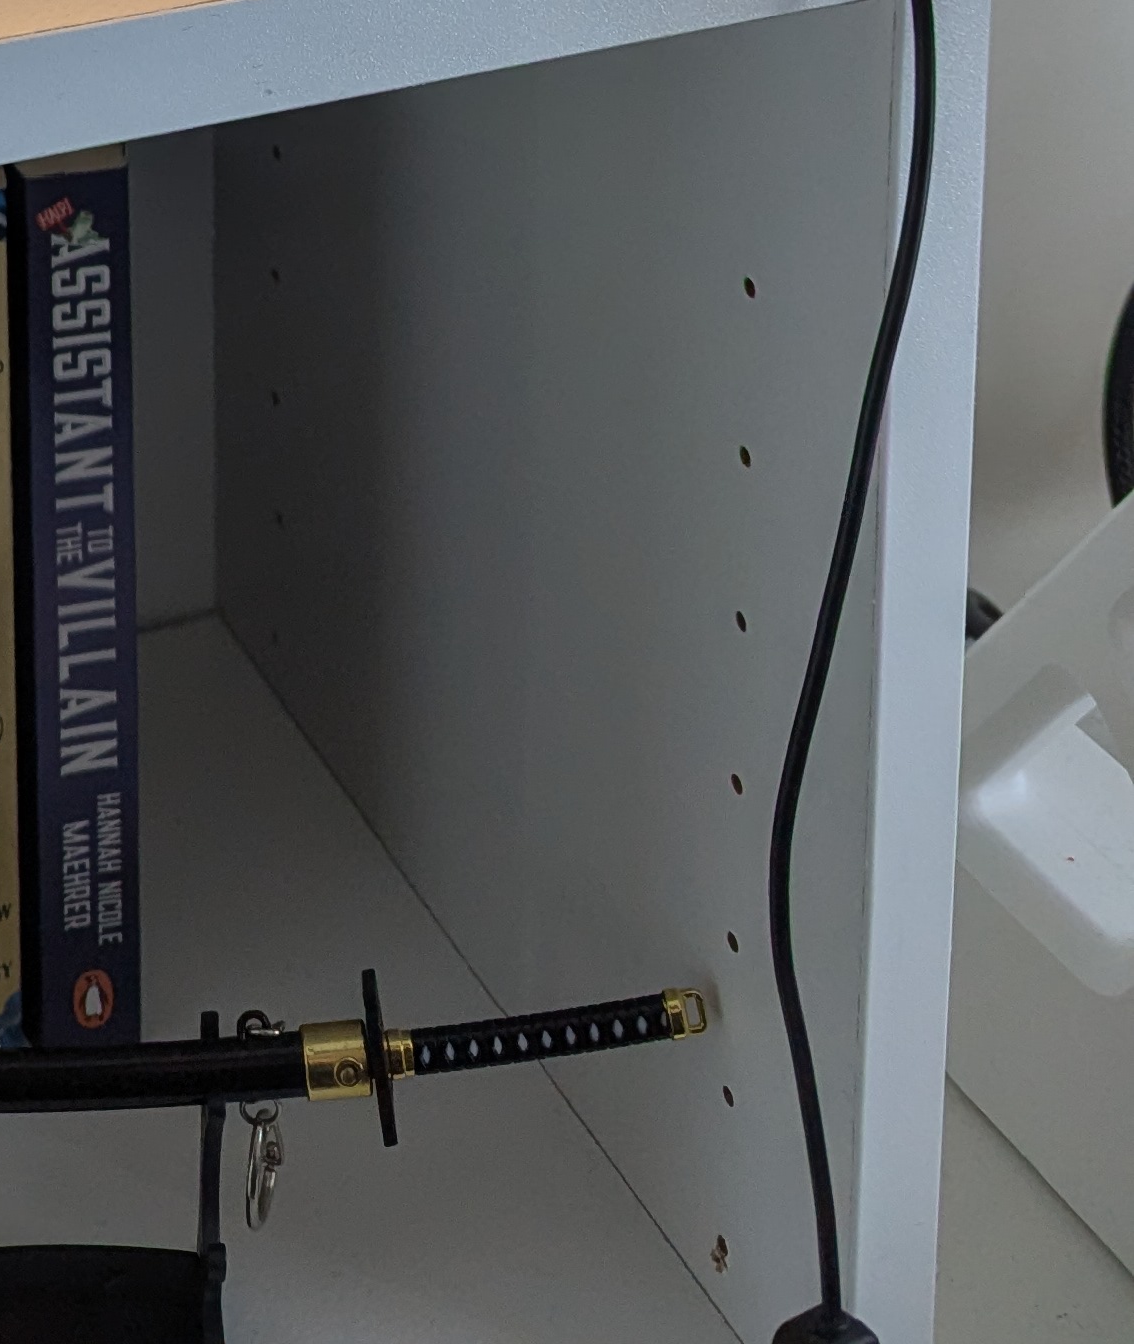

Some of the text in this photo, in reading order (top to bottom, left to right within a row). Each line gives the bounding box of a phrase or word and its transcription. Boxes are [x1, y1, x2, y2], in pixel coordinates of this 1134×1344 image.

[51, 236, 116, 514] ASSISTANT
[56, 520, 85, 565] THE
[87, 524, 116, 554] TO
[56, 556, 119, 779] VILLAIN
[62, 819, 92, 932] MAEHRER
[96, 791, 124, 948] HANNAH NICOLE
